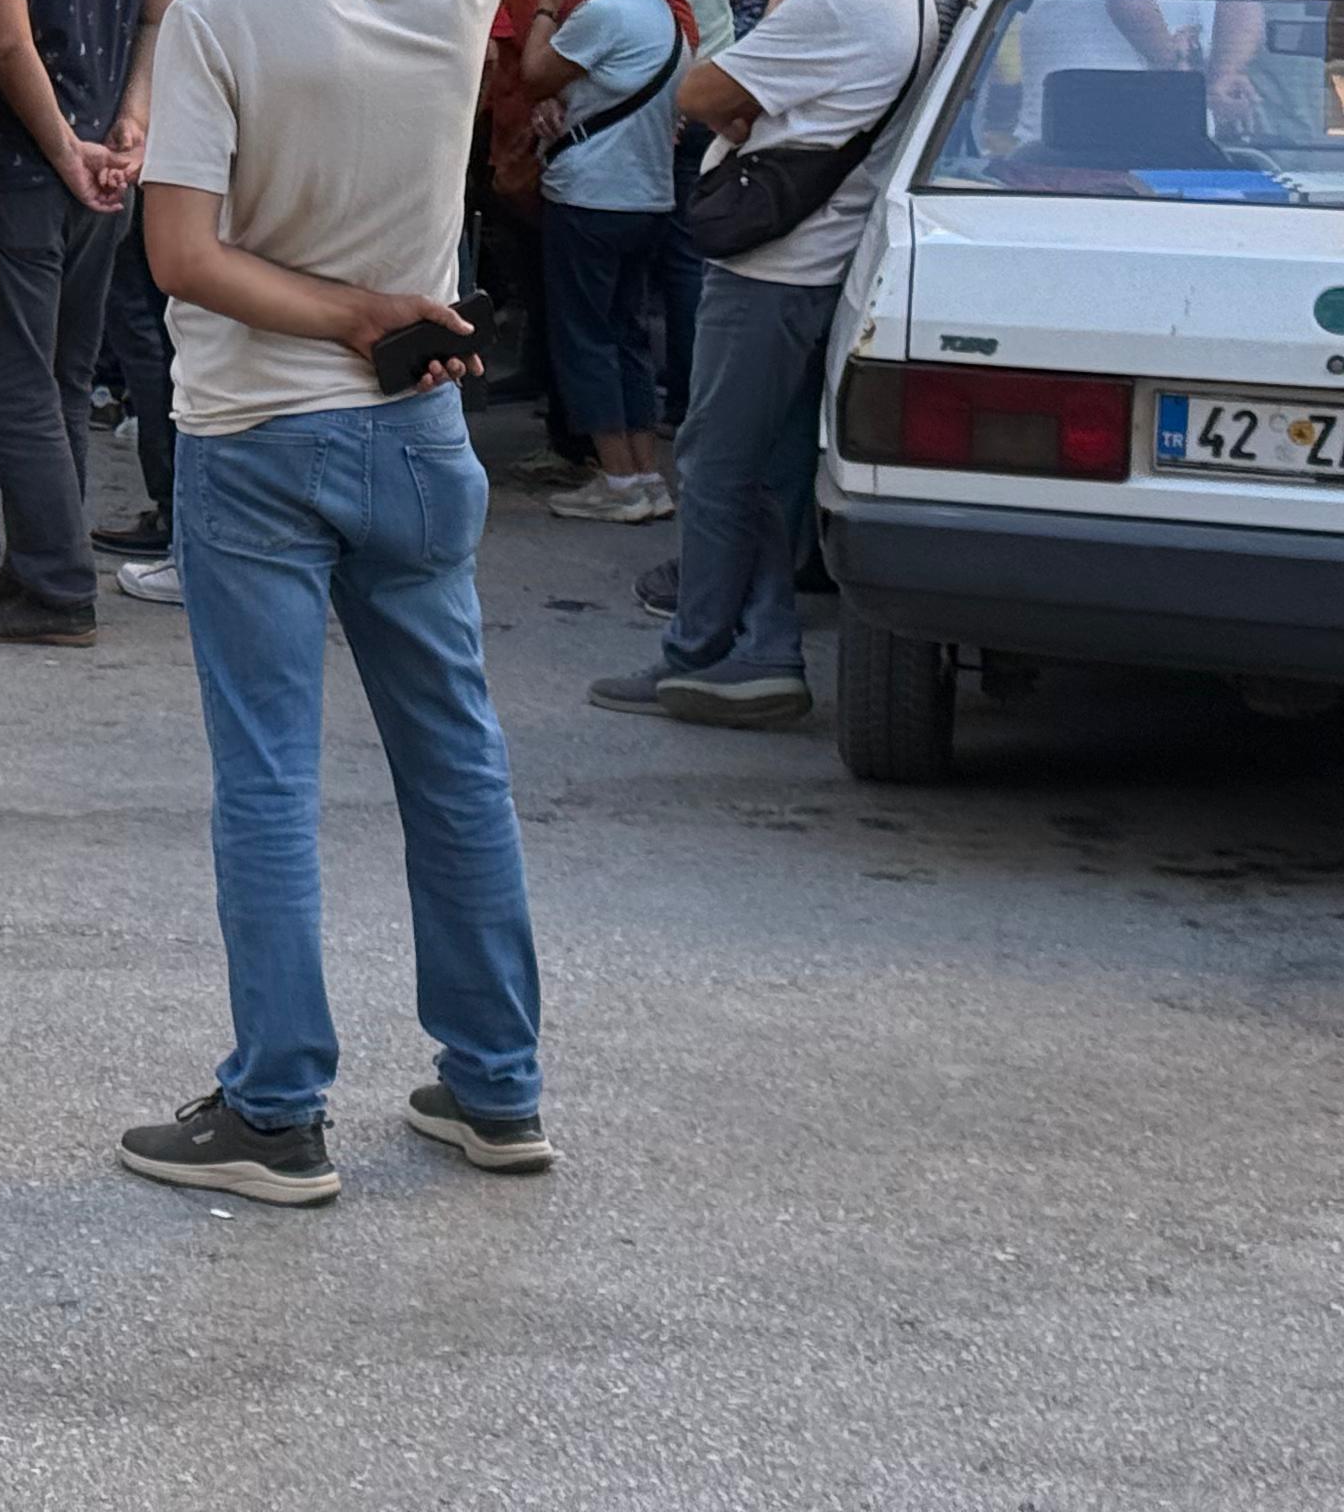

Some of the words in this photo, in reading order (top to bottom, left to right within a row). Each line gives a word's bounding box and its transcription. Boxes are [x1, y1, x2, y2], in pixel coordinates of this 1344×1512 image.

[1162, 430, 1185, 448] TR
[1197, 406, 1258, 461] 42
[1305, 414, 1344, 469] Z
